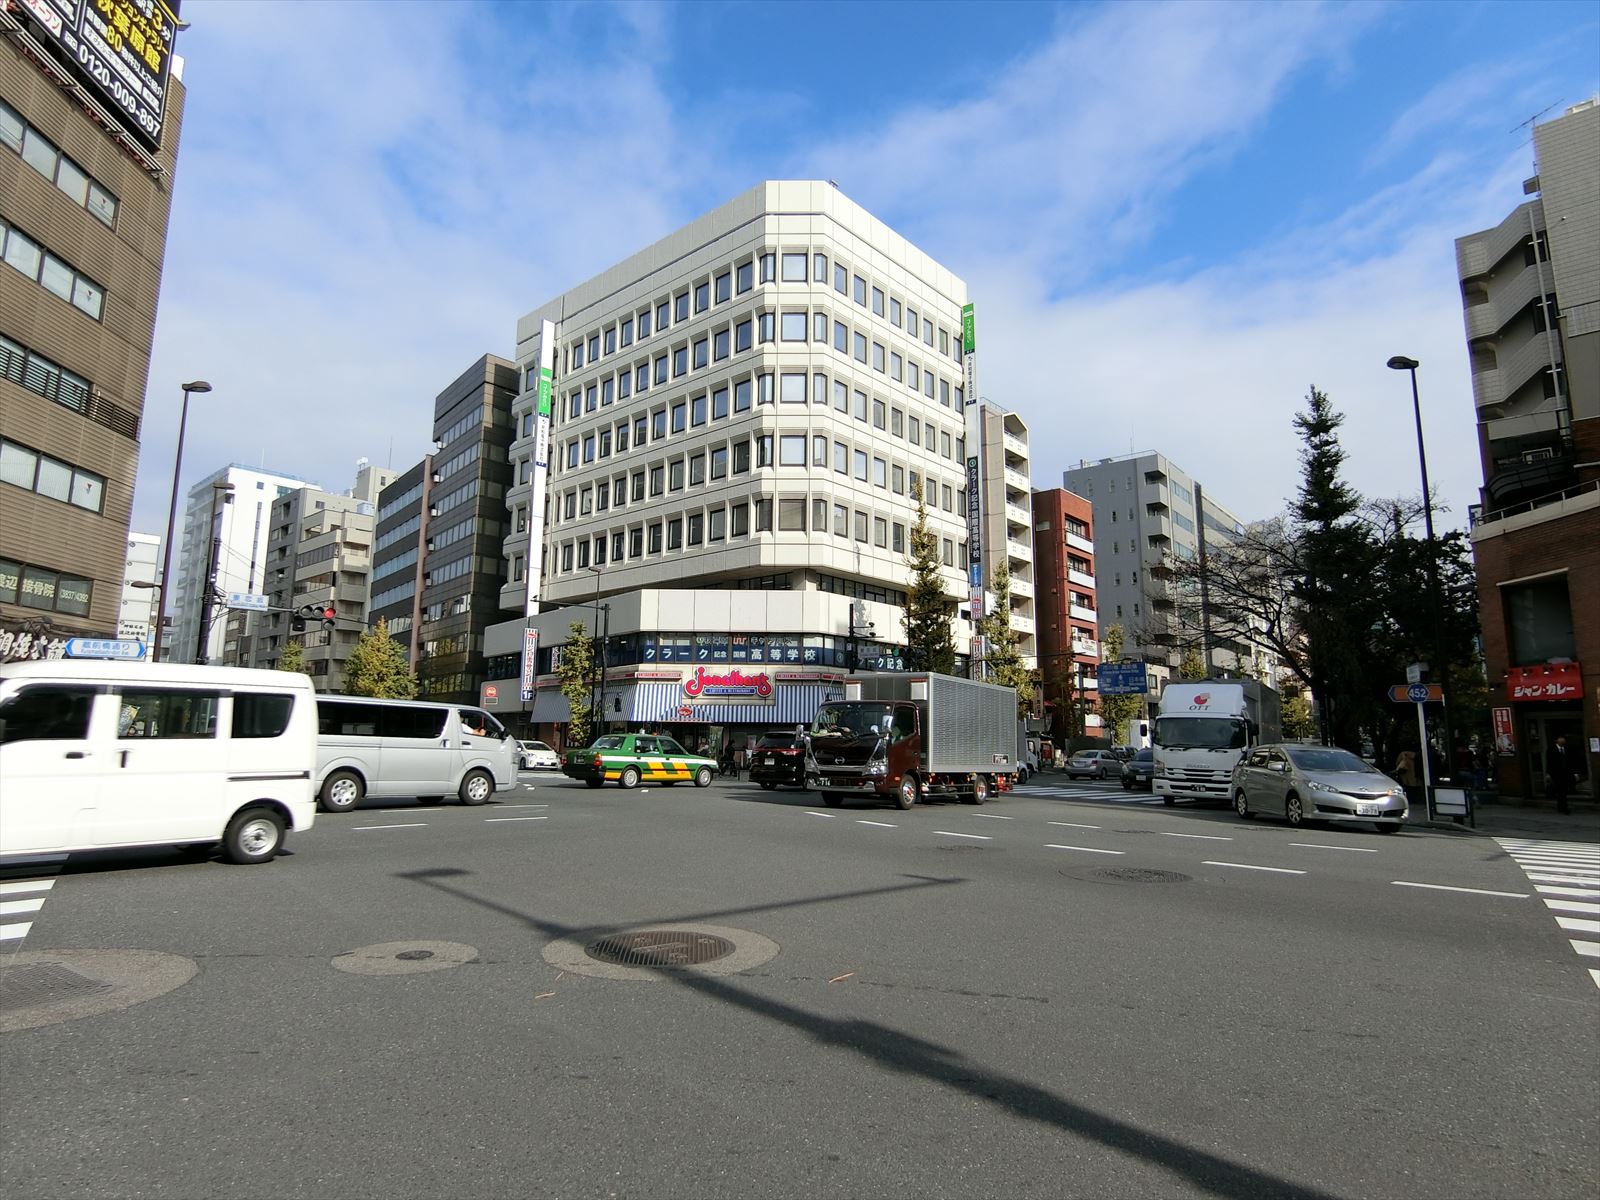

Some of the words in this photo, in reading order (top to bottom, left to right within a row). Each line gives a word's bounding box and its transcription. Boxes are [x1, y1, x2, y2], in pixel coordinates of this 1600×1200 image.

[80, 45, 161, 137] 0120-009-897
[523, 690, 533, 699] 1F
[1409, 689, 1427, 698] 452
[1513, 683, 1576, 698] ジャン・カレー
